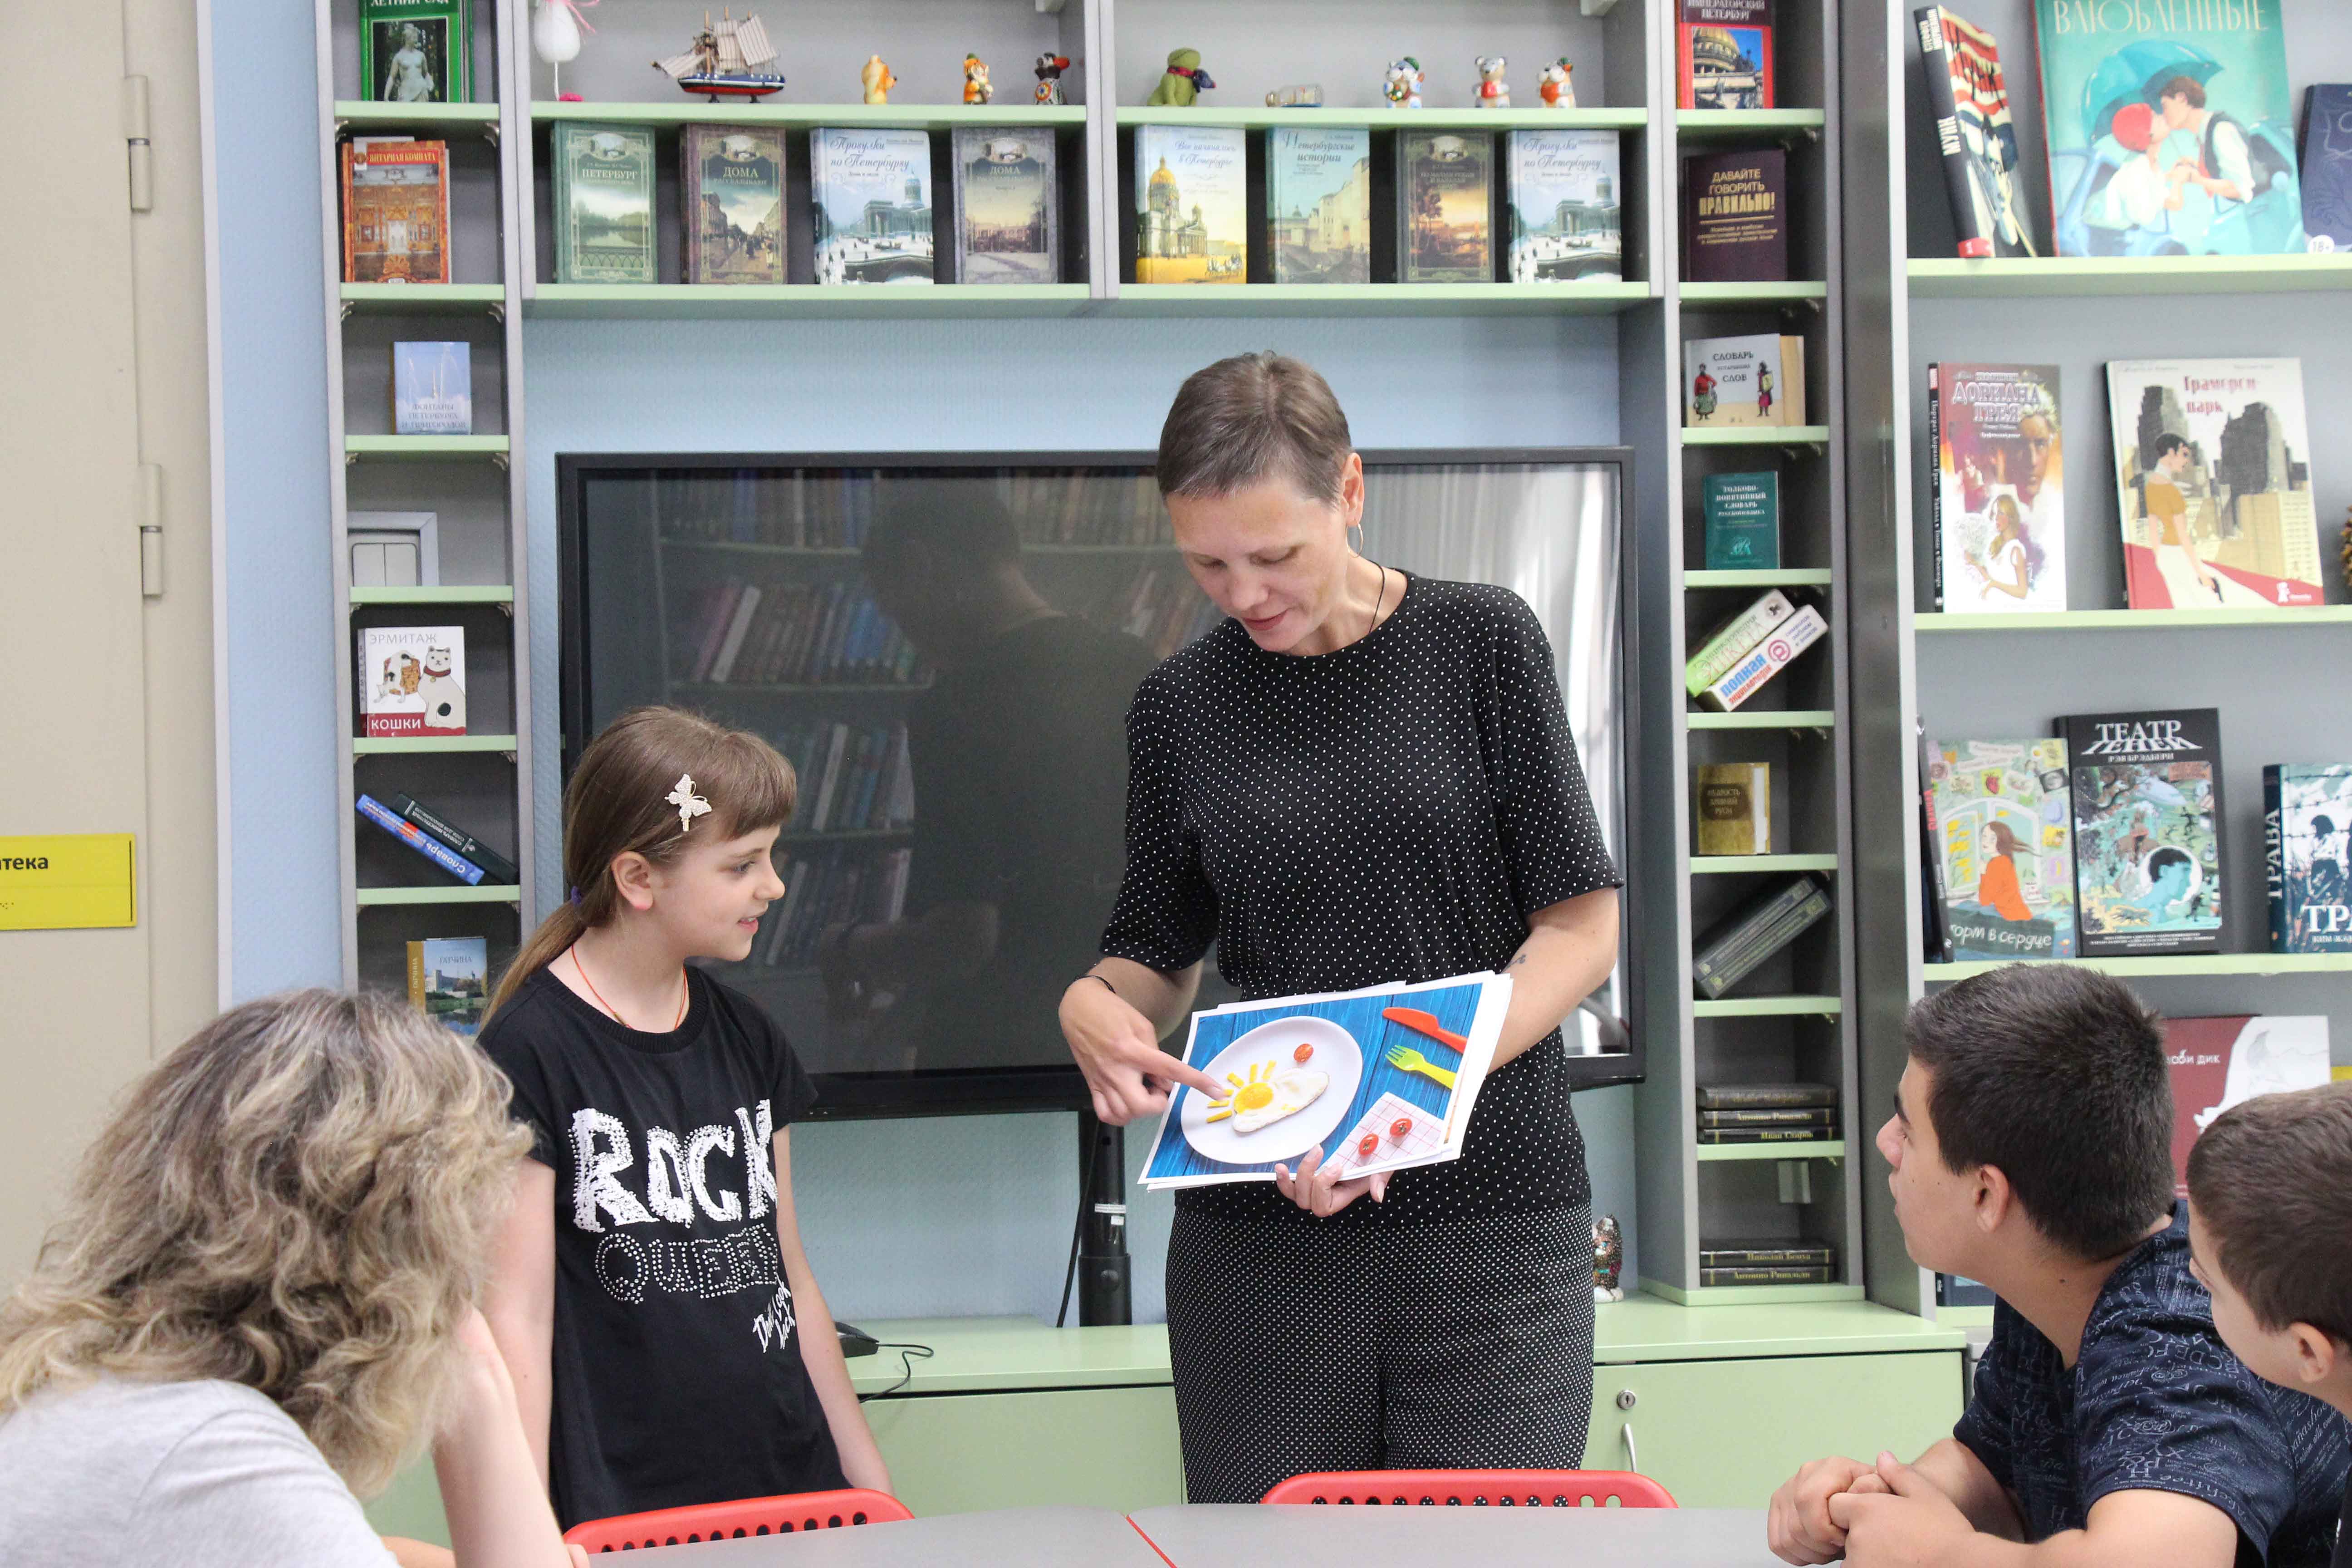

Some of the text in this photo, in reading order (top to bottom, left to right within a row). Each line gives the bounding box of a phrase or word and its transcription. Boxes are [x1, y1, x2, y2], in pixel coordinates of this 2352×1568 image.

[1937, 115, 1961, 156] МУНК
[844, 153, 911, 172] Петербургу
[1296, 155, 1342, 167] истории
[582, 169, 638, 180] ПЕТЕРБУРГ
[723, 166, 759, 178] ДОМА
[990, 166, 1021, 175] ДОМА
[1712, 168, 1761, 183] ДАВАЙТЕ
[1709, 181, 1765, 196] ГОВОРИТЬ
[1699, 191, 1775, 216] ПРАВИЛЬНО!
[1713, 351, 1754, 362] СЛОВАРЬ
[1722, 374, 1747, 382] СЛОВ
[370, 633, 437, 644] ЭРМИТАЖ
[371, 718, 421, 730] КОШКИ
[2095, 720, 2182, 740] ТЕАТР
[426, 843, 466, 873] Словарь
[2265, 809, 2283, 899] ТРАВА
[0, 857, 49, 870] тека
[2300, 905, 2352, 933] ТР
[1999, 931, 2053, 951] сердце
[2196, 1054, 2220, 1065] дик
[568, 1099, 778, 1233] ROCK
[595, 1224, 778, 1304] QUEEN
